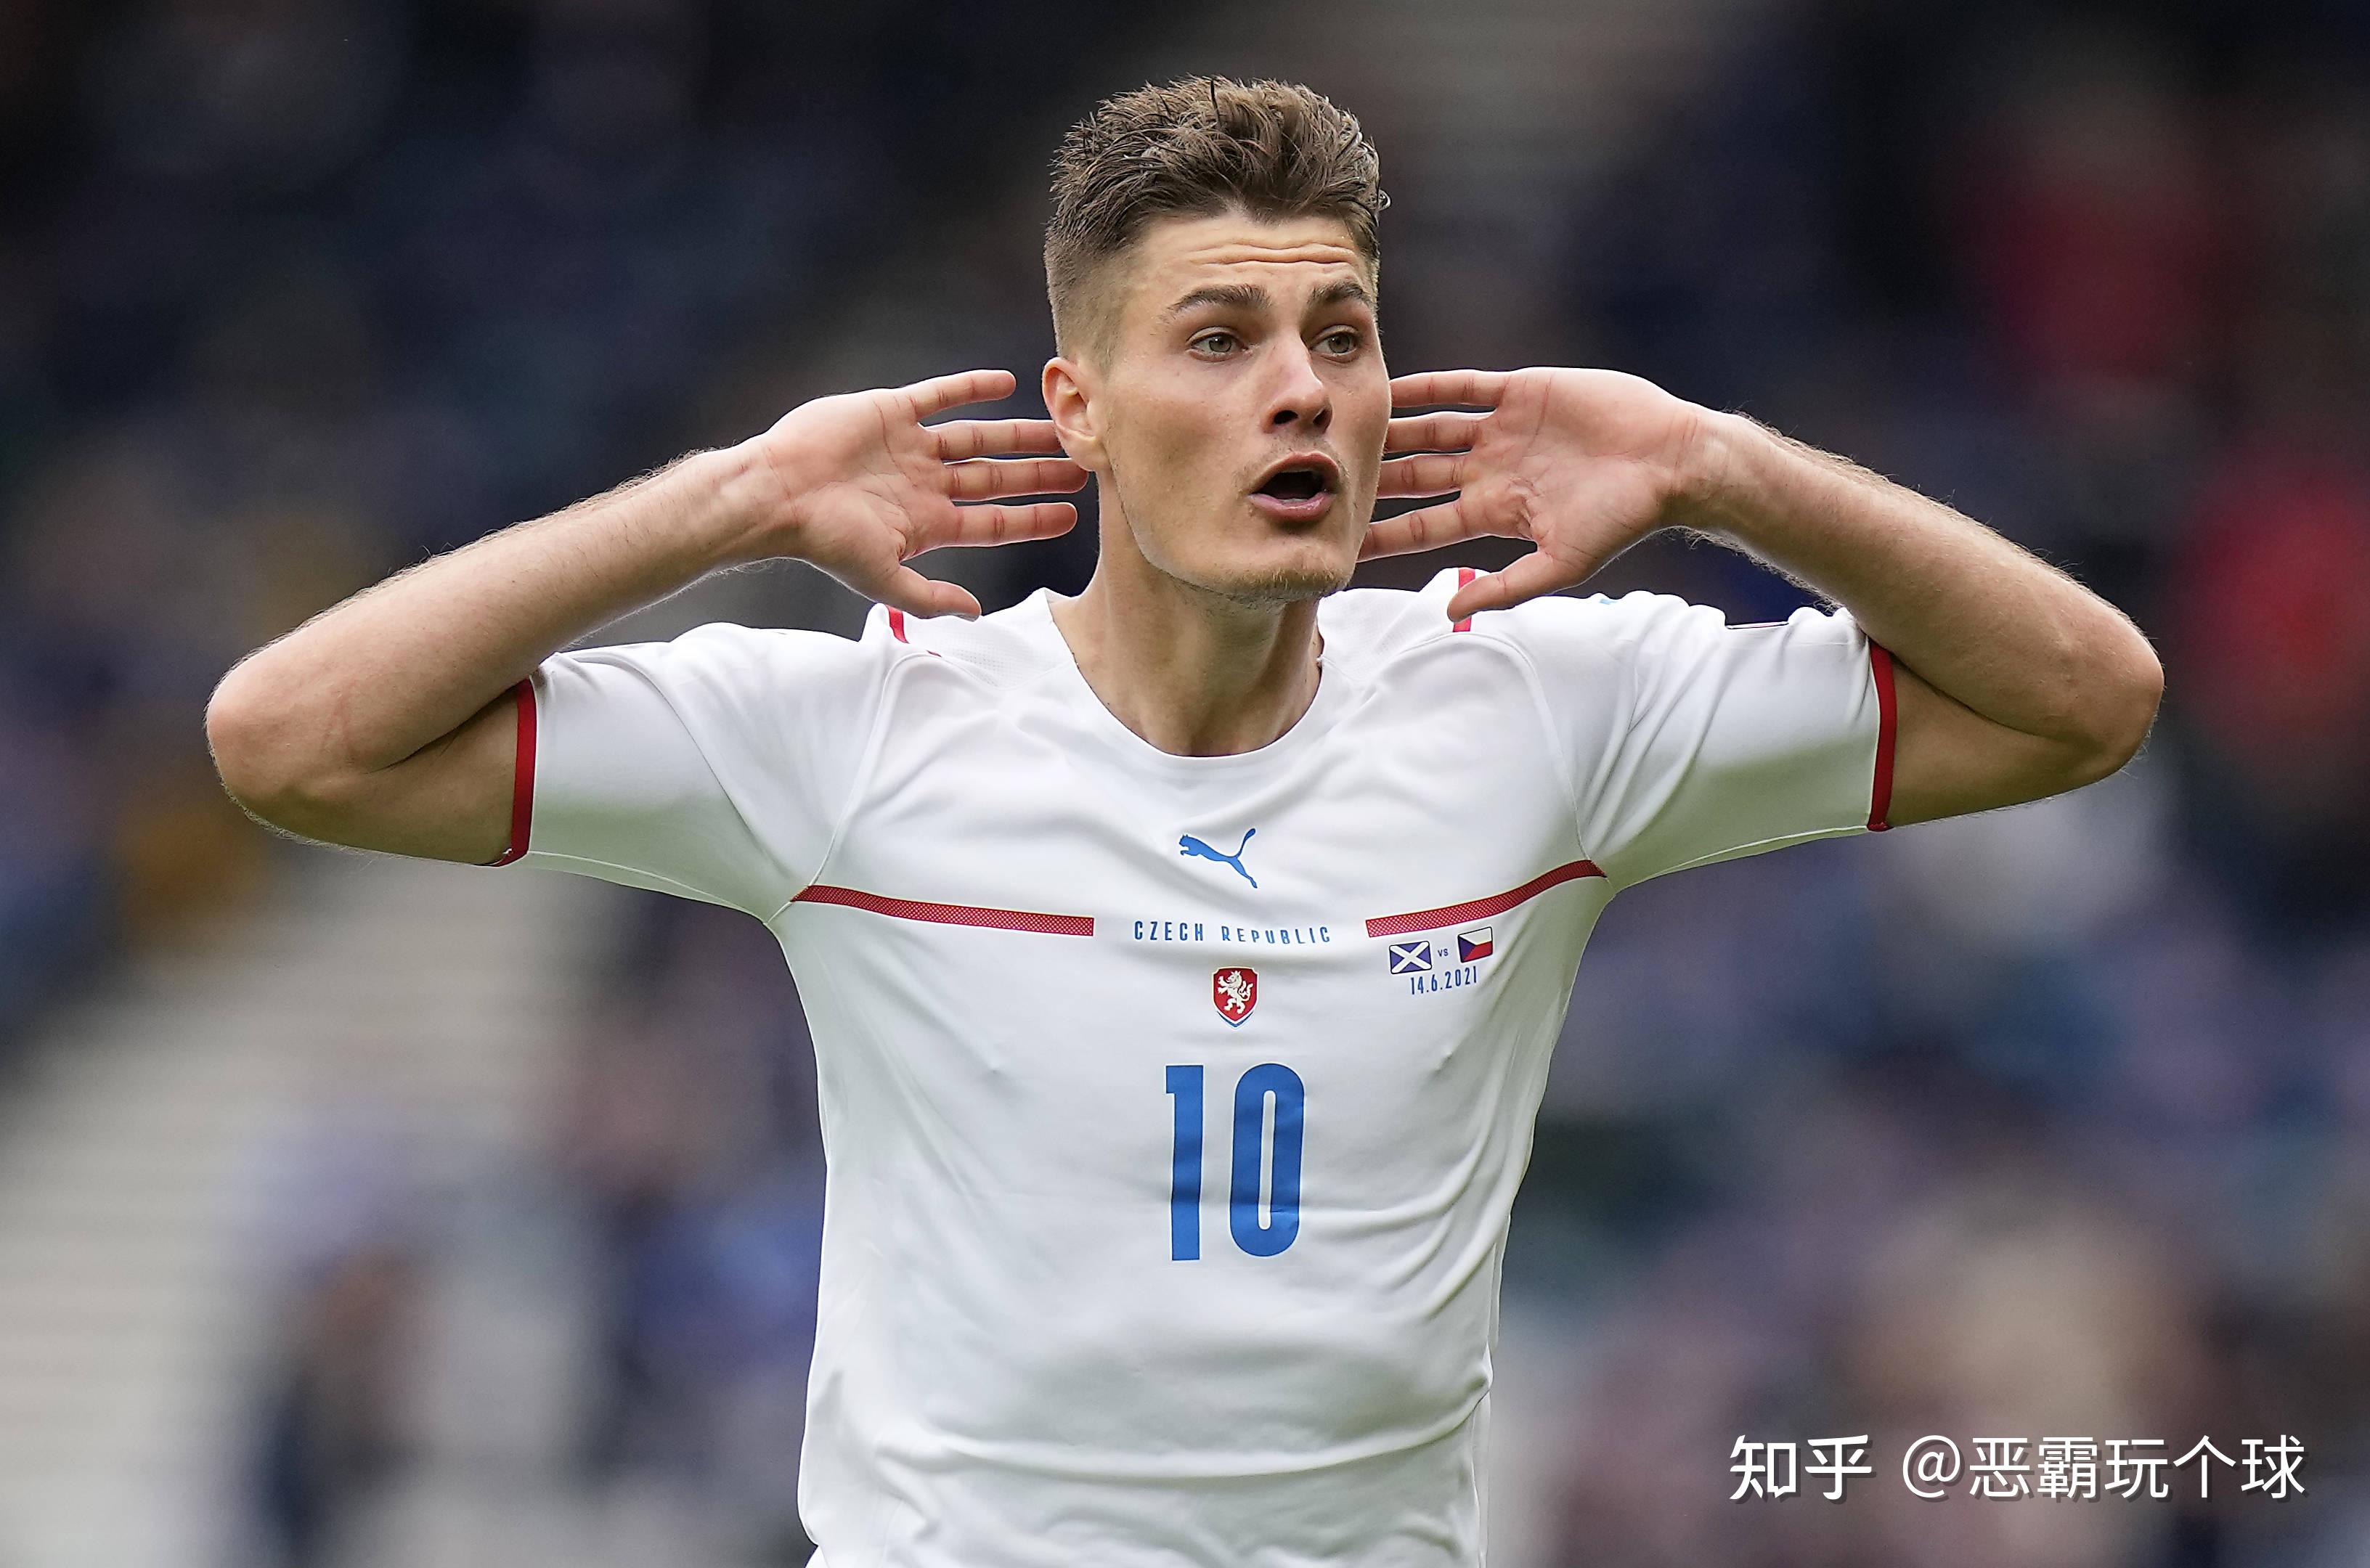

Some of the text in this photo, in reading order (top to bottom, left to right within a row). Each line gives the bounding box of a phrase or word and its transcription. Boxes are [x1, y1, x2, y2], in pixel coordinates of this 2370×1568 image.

[1134, 920, 1330, 944] CZECH REPUBLIC
[1411, 966, 1476, 995] 14.6.2021
[1165, 1063, 1305, 1261] 10
